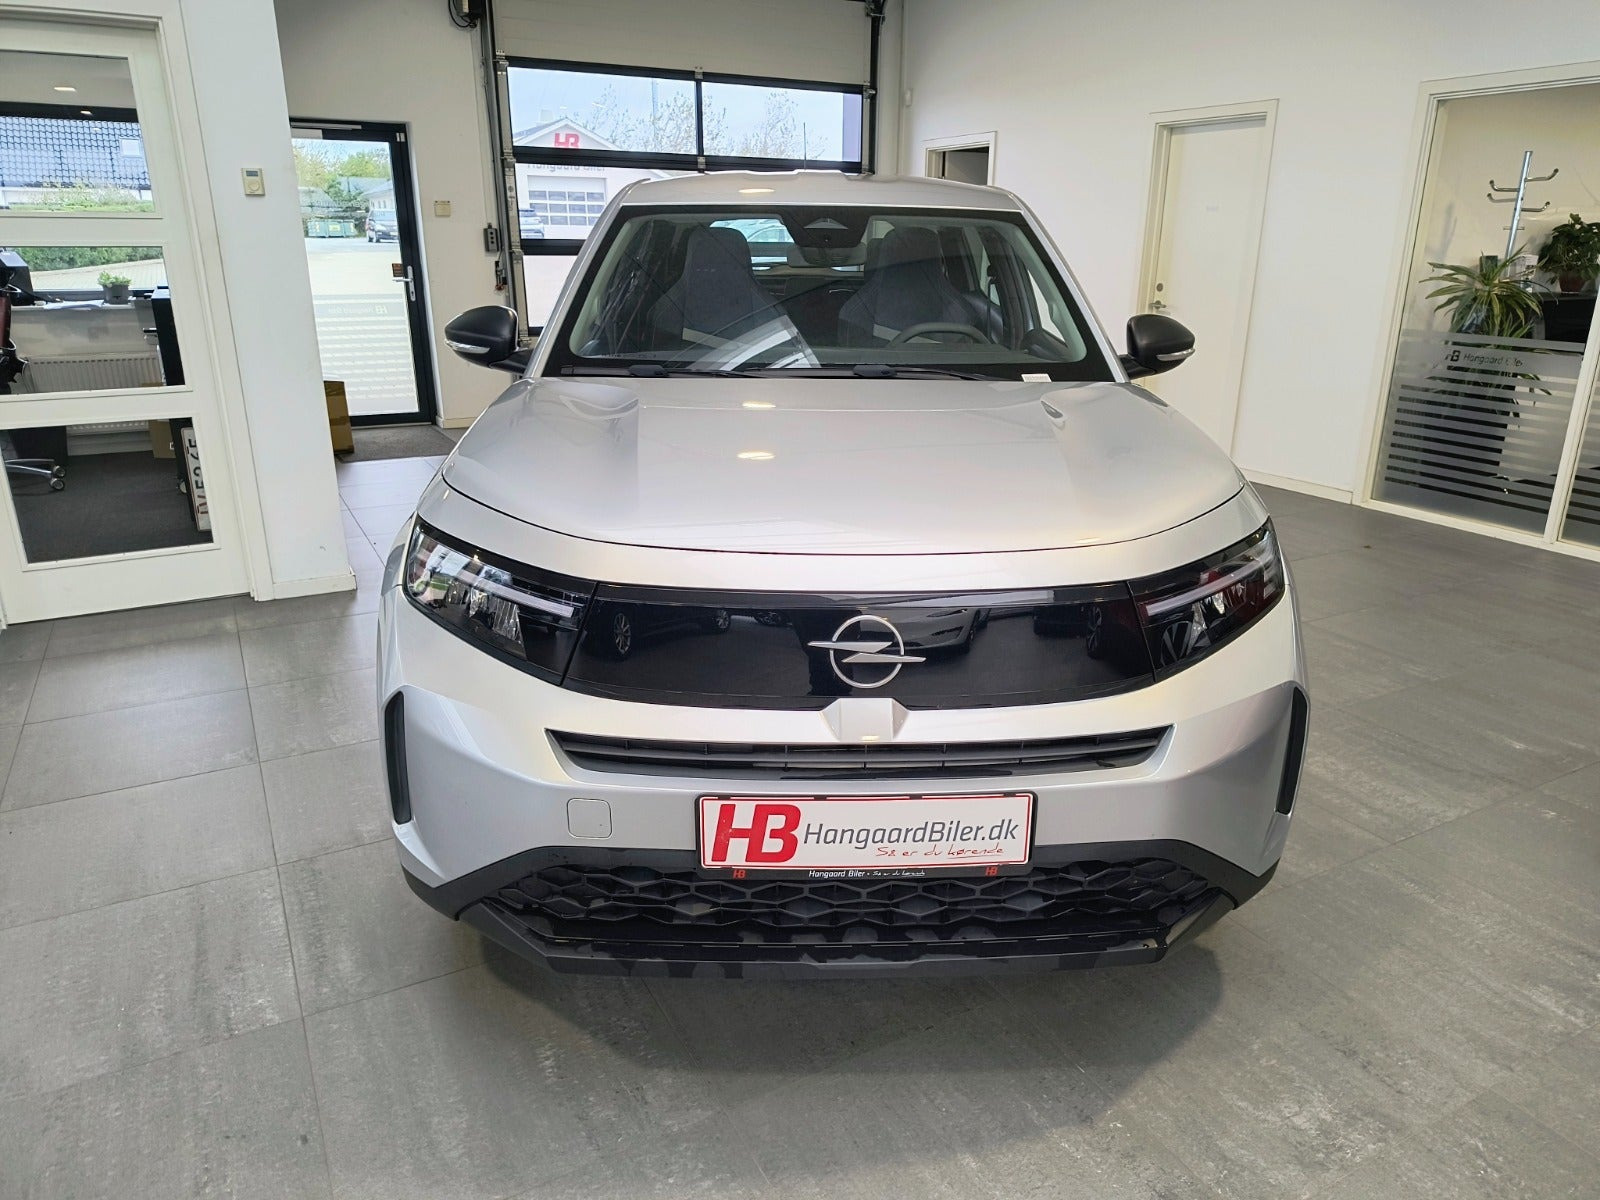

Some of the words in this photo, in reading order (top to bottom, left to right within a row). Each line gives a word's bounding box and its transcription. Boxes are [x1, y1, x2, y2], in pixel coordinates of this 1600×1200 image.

[711, 803, 802, 863] HB
[803, 818, 1019, 849] HangaardBiler.dk
[924, 844, 942, 856] du
[948, 842, 1005, 858] kørende
[808, 870, 846, 879] Hangaard
[847, 869, 866, 877] Biler
